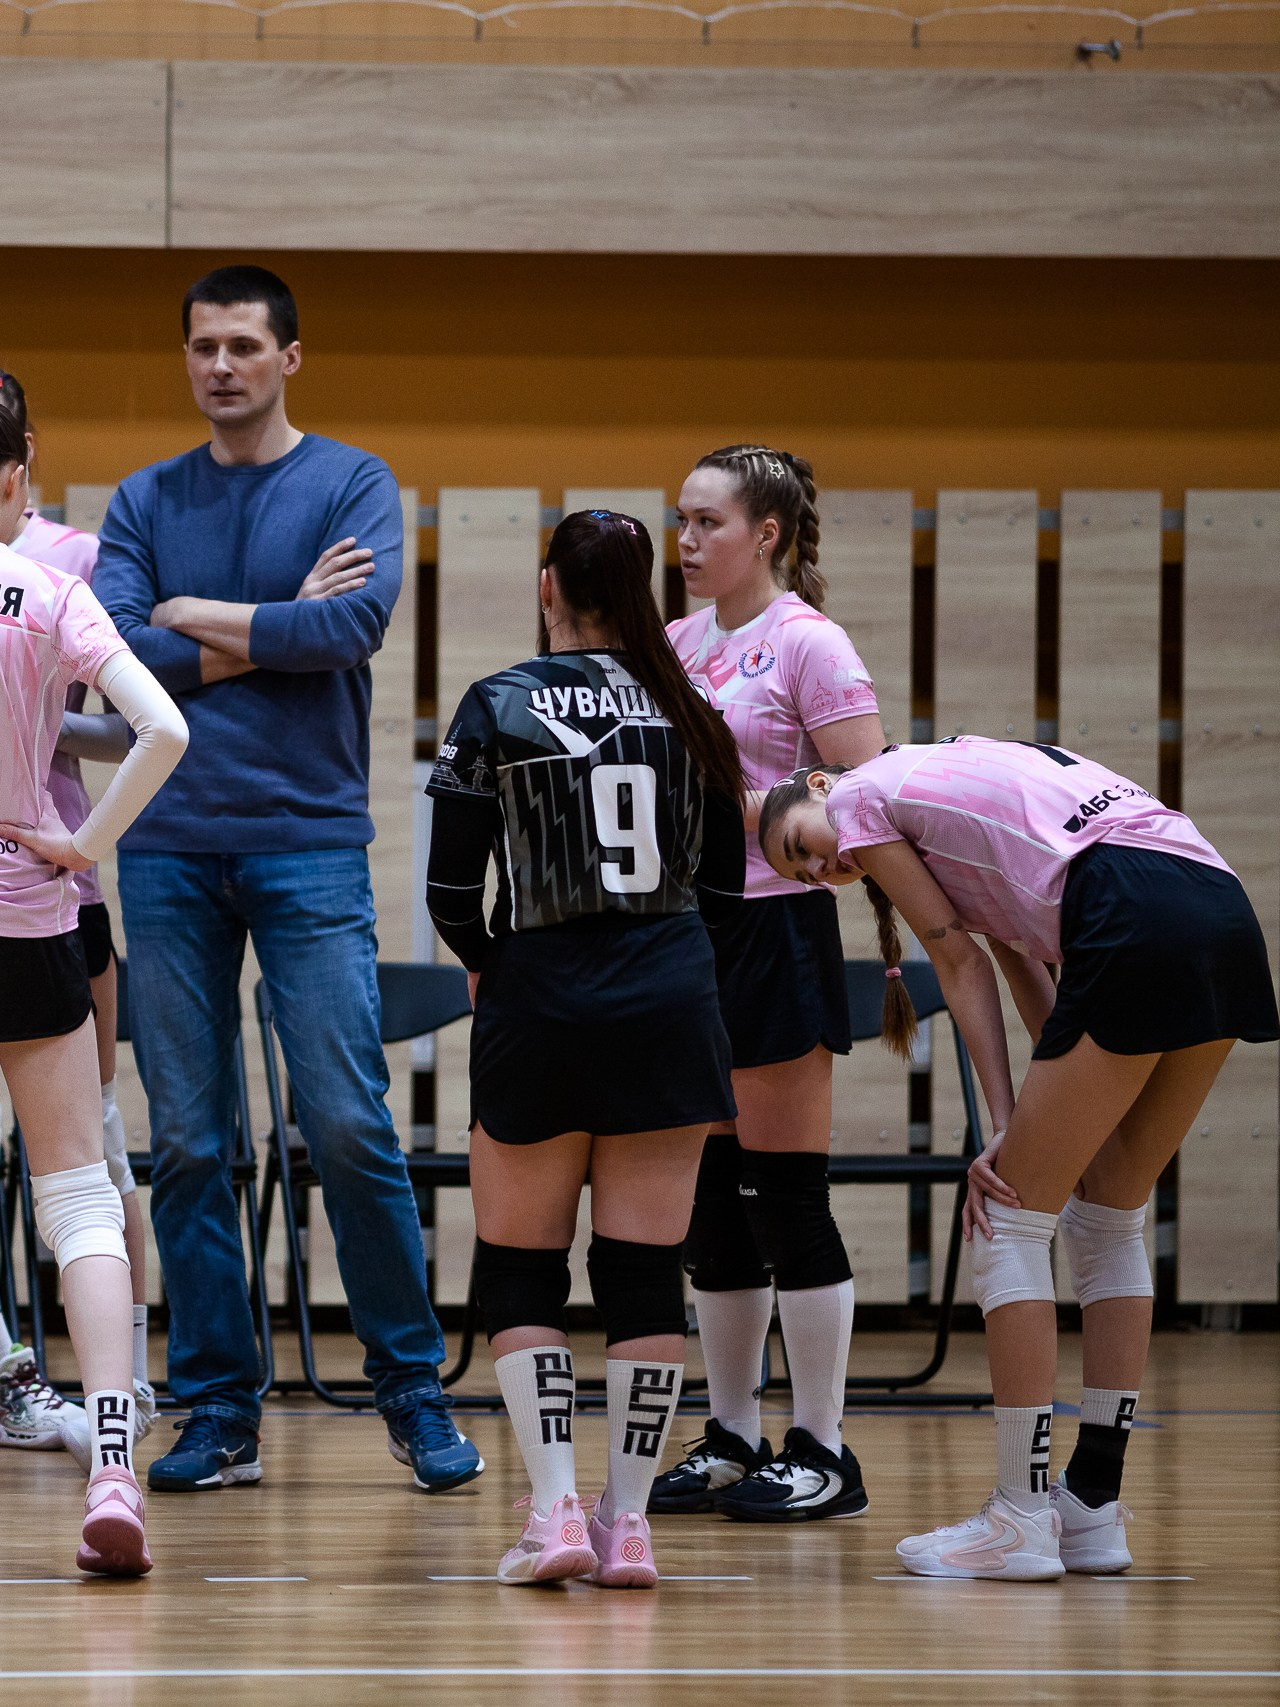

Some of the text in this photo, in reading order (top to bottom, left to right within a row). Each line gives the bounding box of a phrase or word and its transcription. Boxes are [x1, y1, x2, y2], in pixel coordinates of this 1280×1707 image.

[530, 685, 666, 720] ЧУВАШ
[440, 744, 459, 760] ФВ
[590, 764, 661, 894] 9
[1078, 786, 1121, 820] АБС
[98, 1396, 130, 1471] ELITE
[533, 1353, 574, 1445] ELITE
[622, 1367, 676, 1459] ELITE
